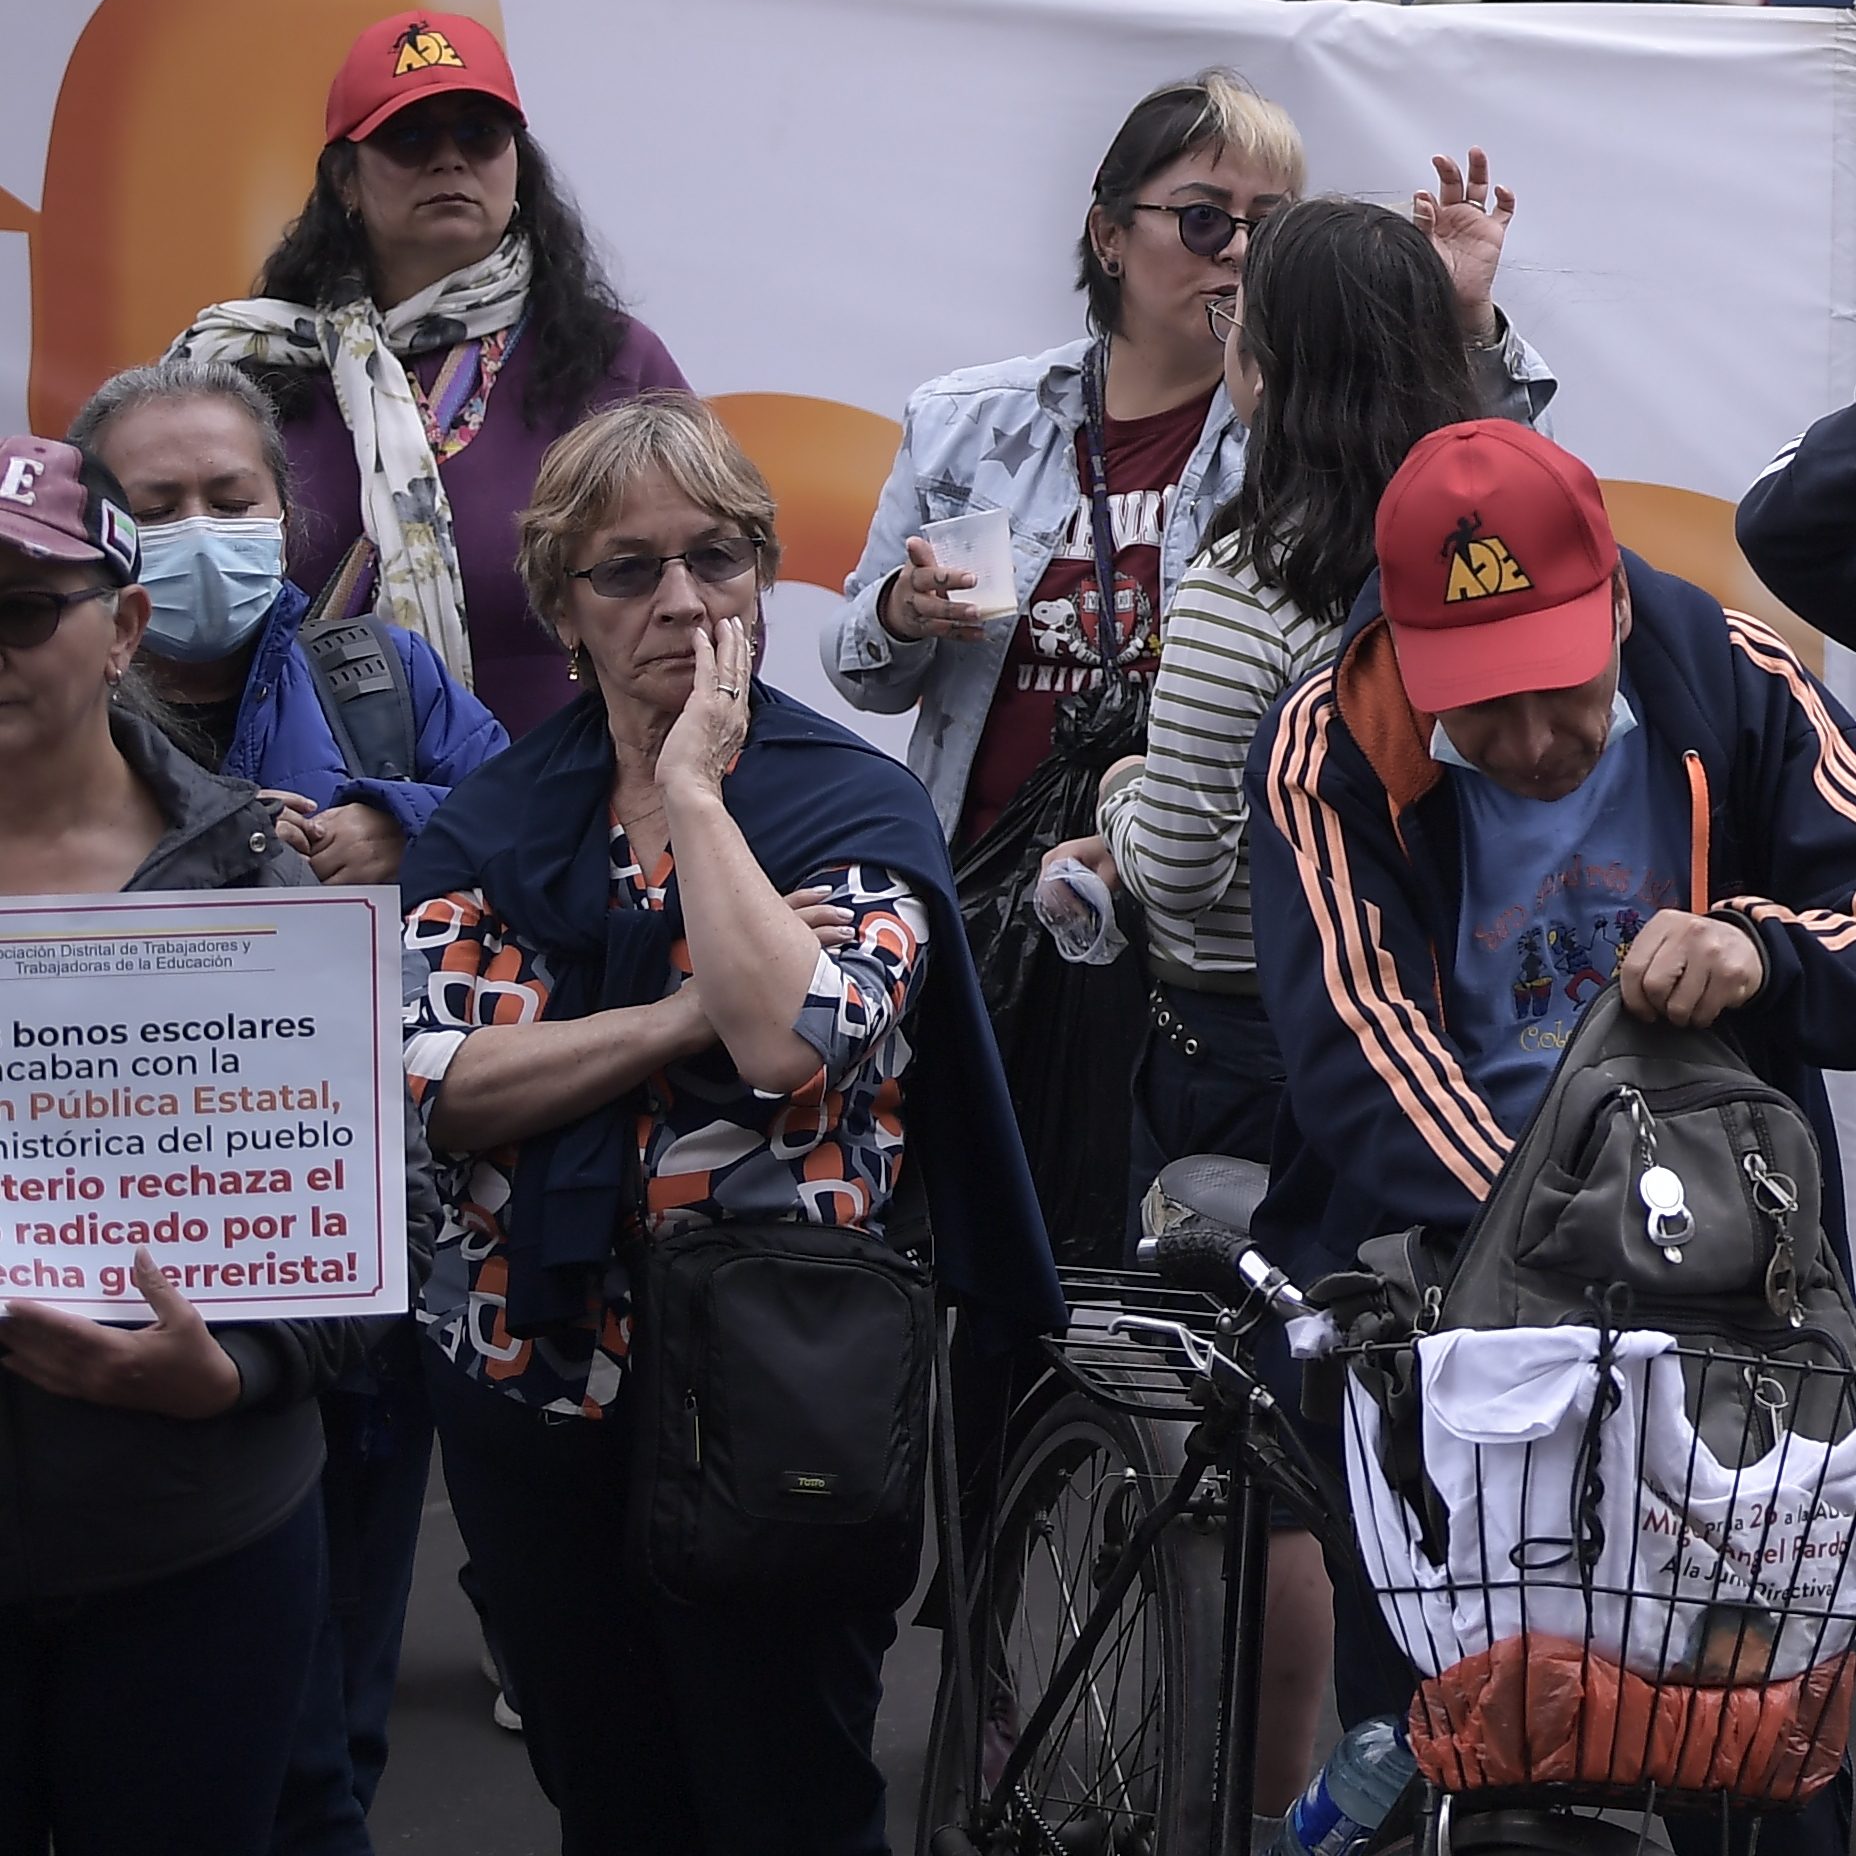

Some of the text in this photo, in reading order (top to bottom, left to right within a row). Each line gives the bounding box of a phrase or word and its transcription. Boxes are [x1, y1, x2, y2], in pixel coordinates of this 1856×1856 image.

[1444, 535, 1534, 604] ADE
[16, 954, 233, 976] Trabajadoras de la Educación
[60, 943, 116, 958] Distrital
[120, 942, 139, 956] de
[143, 939, 239, 957] Trabajadores
[242, 941, 251, 954] y
[13, 1020, 128, 1049] bonos
[140, 1013, 317, 1043] escolares
[0, 1047, 241, 1082] caban con la
[30, 1086, 179, 1122] Pública
[194, 1080, 343, 1116] Estatal,
[158, 1124, 213, 1155] del
[227, 1120, 354, 1158] pueblo
[119, 1165, 293, 1200] rechaza
[306, 1159, 346, 1192] el
[16, 1206, 348, 1249] radicado por la
[99, 1252, 358, 1297] gerrerista!
